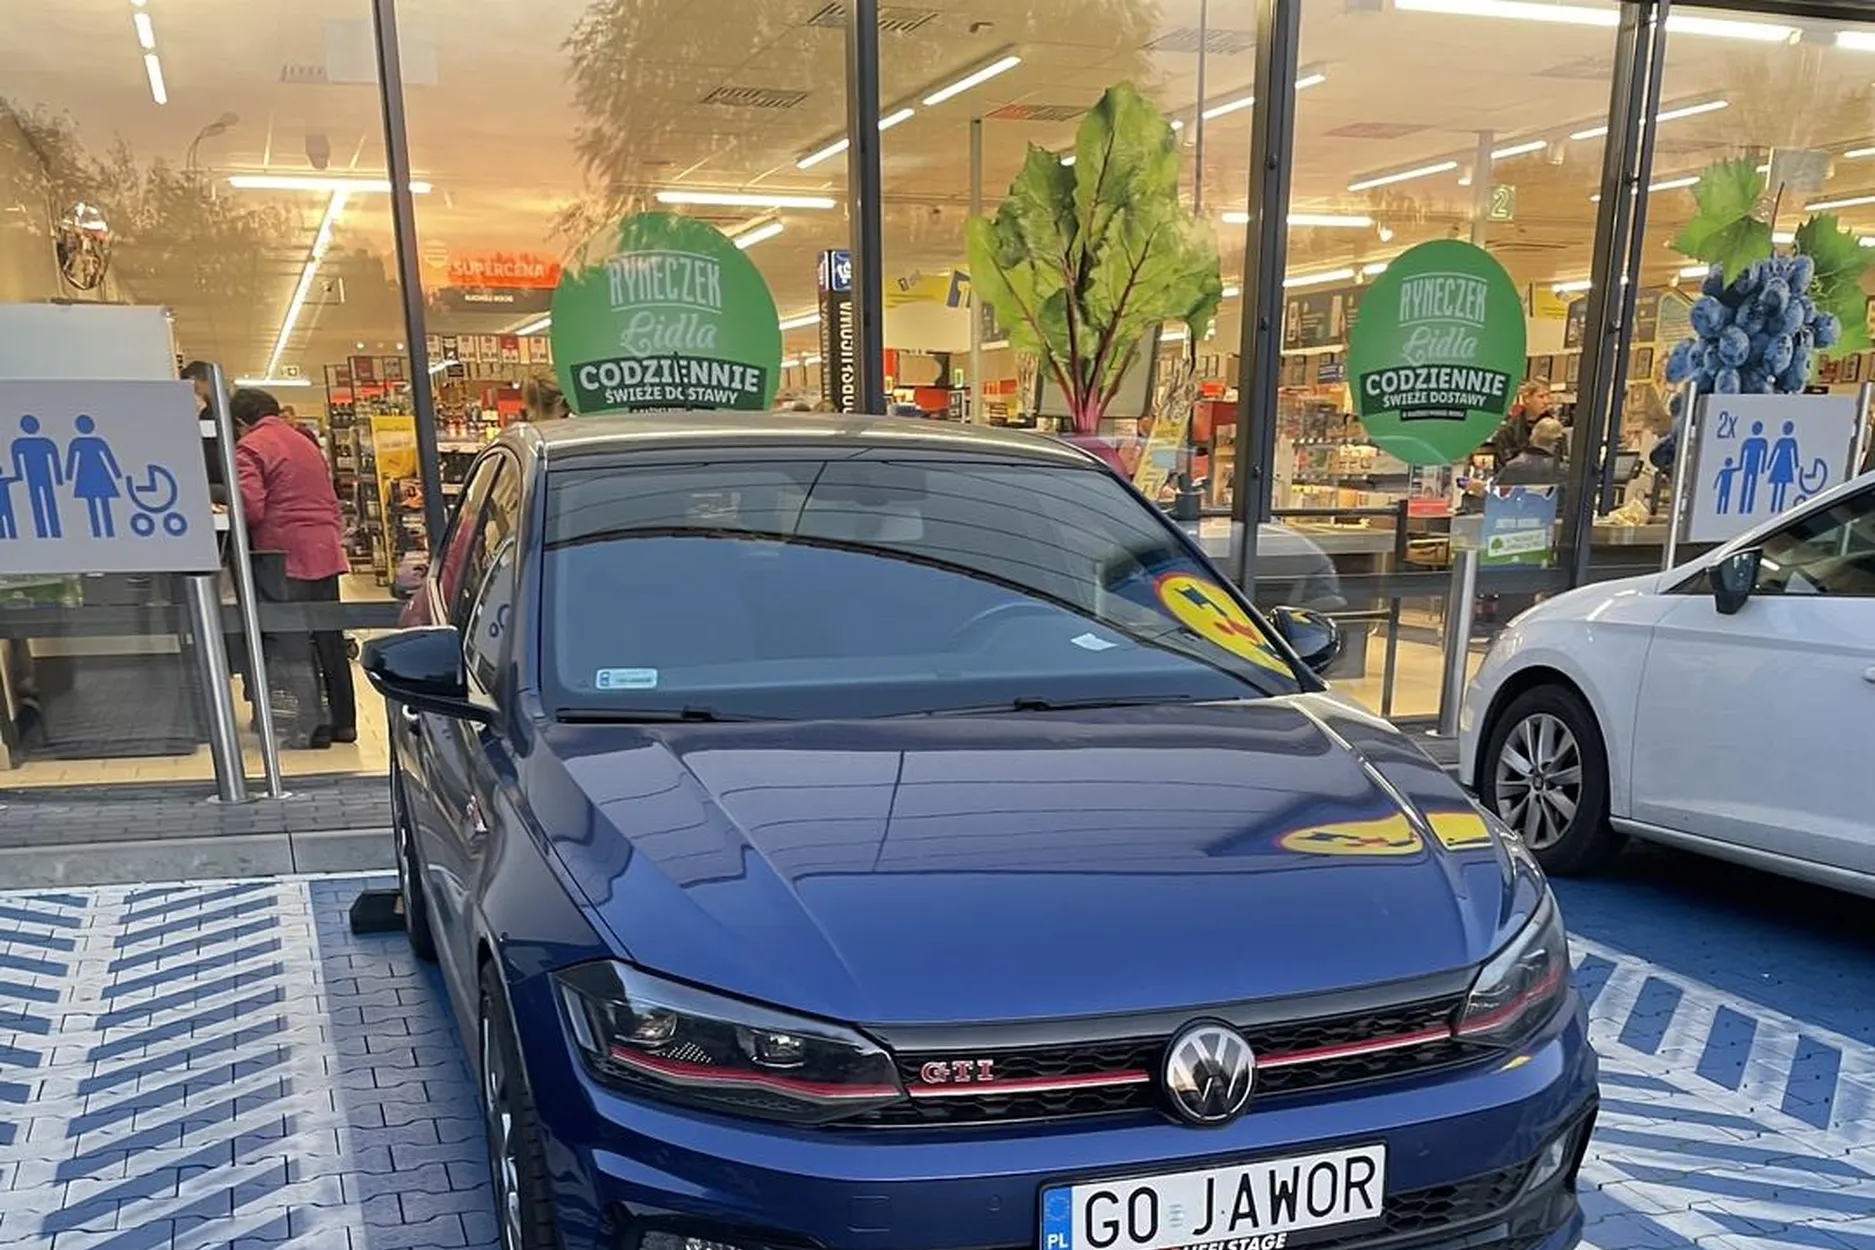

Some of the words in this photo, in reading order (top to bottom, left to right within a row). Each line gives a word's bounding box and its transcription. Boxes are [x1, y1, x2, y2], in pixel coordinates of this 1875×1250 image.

[1491, 188, 1509, 217] 2
[452, 261, 545, 277] SUPERCENA
[608, 256, 722, 308] RYNECZEK
[1400, 277, 1487, 322] RYNECZEK
[620, 311, 718, 358] Lidla
[1400, 326, 1478, 367] Lidla
[579, 359, 760, 393] CODZIENNIE
[1366, 367, 1506, 396] CODZIENNIE
[605, 386, 662, 404] ŚWIEŻE
[1383, 391, 1428, 408] ŚWIEŻE
[1430, 392, 1487, 407] DOSTAWY
[1717, 411, 1738, 438] 2x
[921, 1059, 995, 1083] GTI
[1085, 1186, 1159, 1249] GO
[1192, 1155, 1376, 1236] JAWOR
[1047, 1232, 1069, 1250] PL
